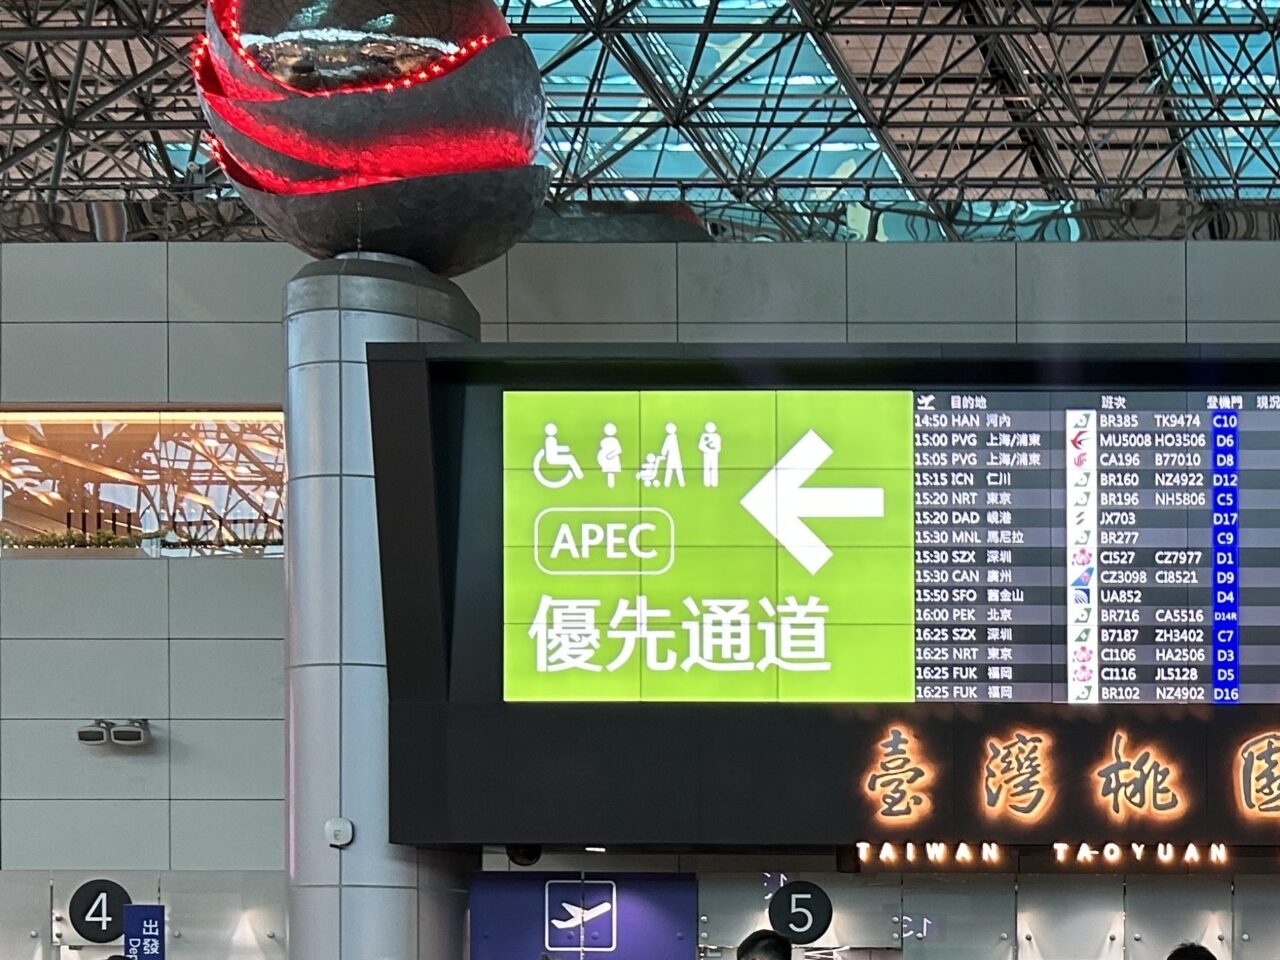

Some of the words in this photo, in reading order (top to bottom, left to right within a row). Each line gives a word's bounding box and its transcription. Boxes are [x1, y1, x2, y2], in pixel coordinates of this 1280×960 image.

[951, 396, 986, 409] 目的地
[1102, 396, 1125, 409] 班次
[1207, 396, 1242, 409] 登機門
[1257, 396, 1280, 409] 現況
[915, 414, 947, 427] 14:50
[952, 415, 979, 426] HAN
[1101, 415, 1138, 427] BR385
[1155, 415, 1200, 427] TK9474
[1213, 416, 1237, 427] C10
[916, 453, 947, 465] 15:05
[952, 453, 977, 465] PVG
[1100, 453, 1139, 466] CA196
[1156, 453, 1201, 466] B77010
[1217, 455, 1233, 466] D8
[916, 493, 948, 505] 15:20
[953, 492, 977, 504] NRT
[1101, 493, 1139, 505] BR196
[1156, 493, 1205, 505] NH5806
[1217, 494, 1233, 505] C5
[550, 523, 658, 559] APEC
[916, 531, 948, 543] 15:30
[953, 531, 980, 543] MNL
[1101, 532, 1138, 544] BR277
[1218, 533, 1234, 544] C9
[916, 570, 948, 582] 15:30
[952, 570, 979, 582] CAN
[1101, 571, 1147, 583] CZ3098
[1156, 571, 1198, 583] CI8521
[1218, 572, 1234, 583] D9
[917, 609, 949, 621] 16:00
[953, 609, 975, 620] PEK
[1102, 610, 1139, 621] BR716
[1156, 610, 1203, 622] CA5516
[528, 594, 832, 673] 優先通道
[917, 648, 948, 660] 16:25
[953, 648, 978, 659] NRT
[1101, 649, 1136, 661] CI106
[1156, 649, 1205, 661] HA2506
[1218, 650, 1234, 661] D3
[917, 687, 949, 698] 16:25
[954, 687, 977, 698] FUK
[1102, 687, 1139, 699] BR102
[1157, 687, 1204, 699] NZ4902
[1214, 688, 1238, 699] D16
[856, 841, 1001, 862] TAIWAN
[1053, 841, 1229, 862] TAOYUAN
[85, 892, 112, 930] 4
[789, 894, 813, 932] 5
[142, 919, 159, 955] 出發
